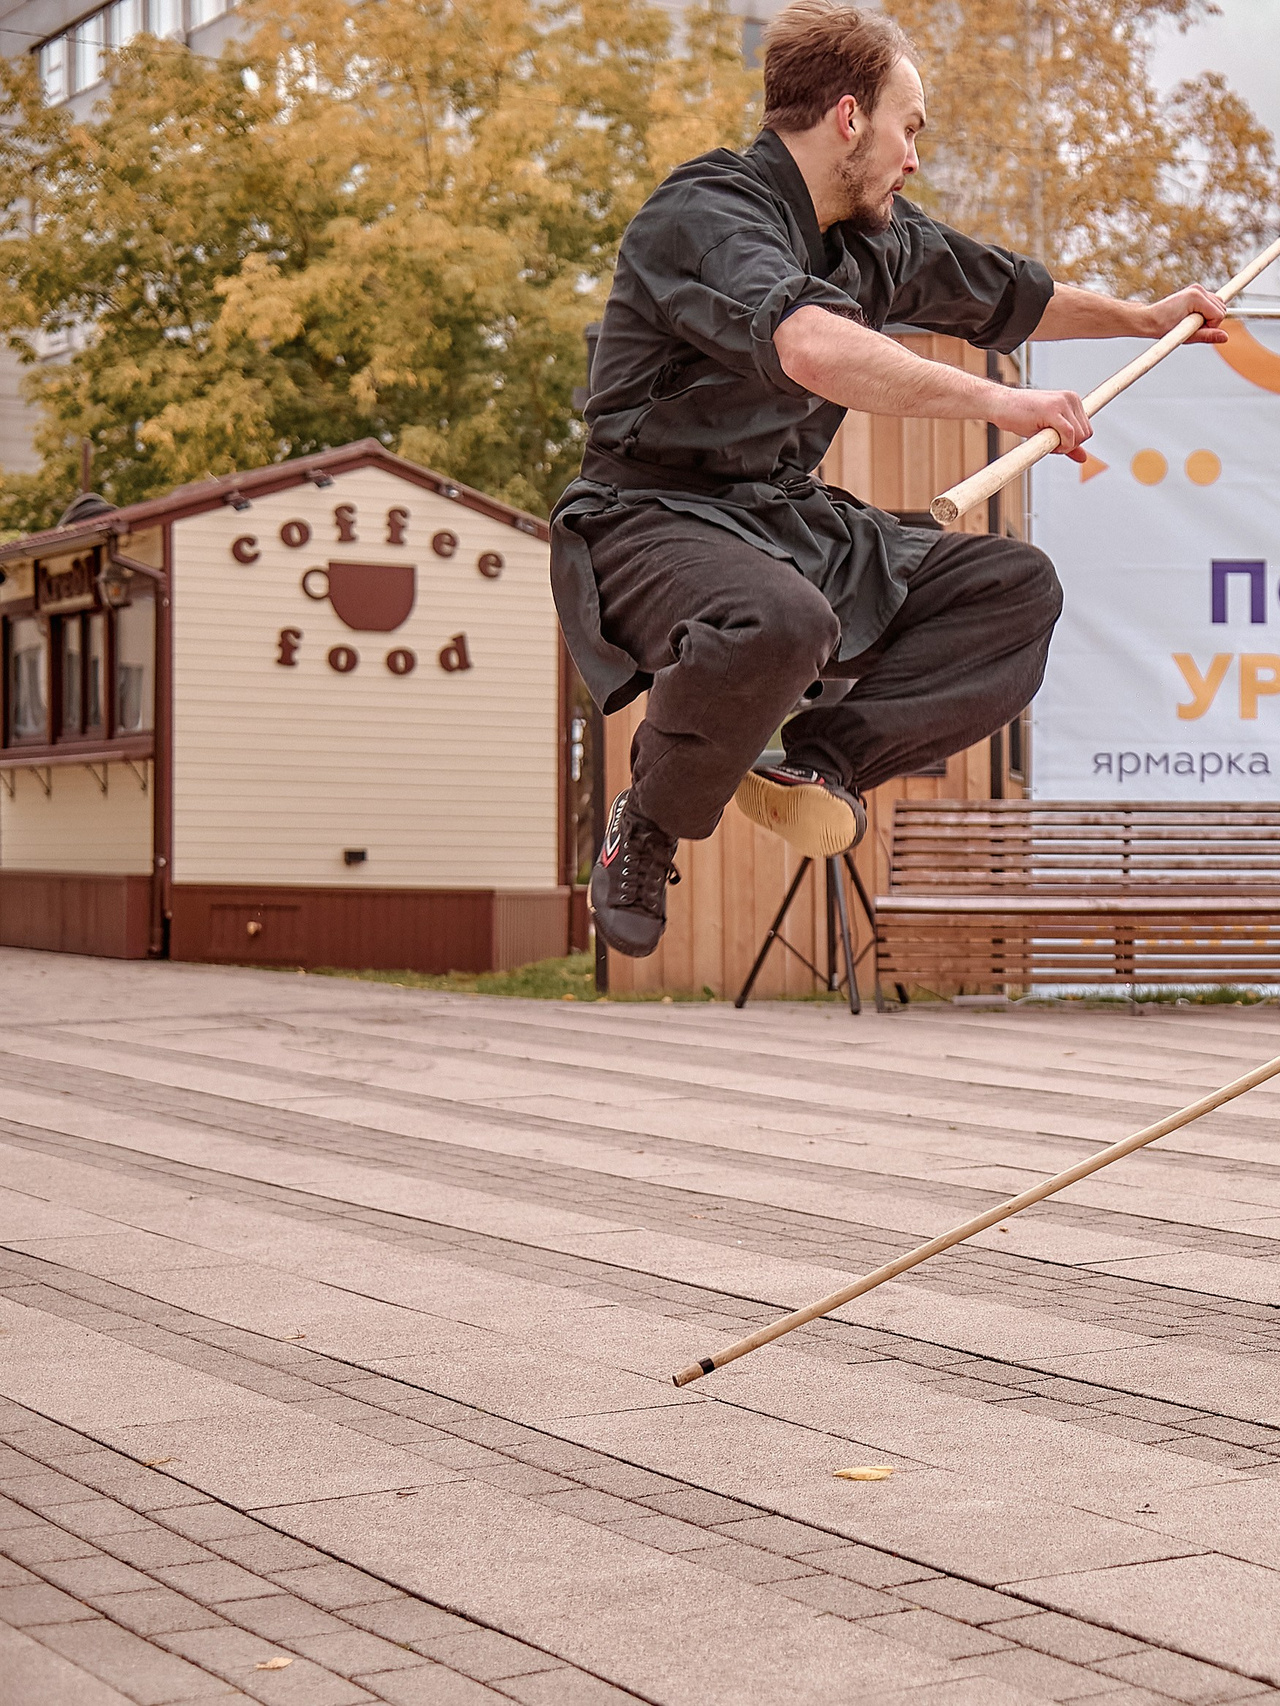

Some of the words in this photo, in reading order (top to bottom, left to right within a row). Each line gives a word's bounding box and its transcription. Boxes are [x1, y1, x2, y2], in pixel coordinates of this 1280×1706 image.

[232, 505, 503, 578] coffee
[276, 628, 472, 675] food
[1093, 752, 1271, 783] ярмарка
